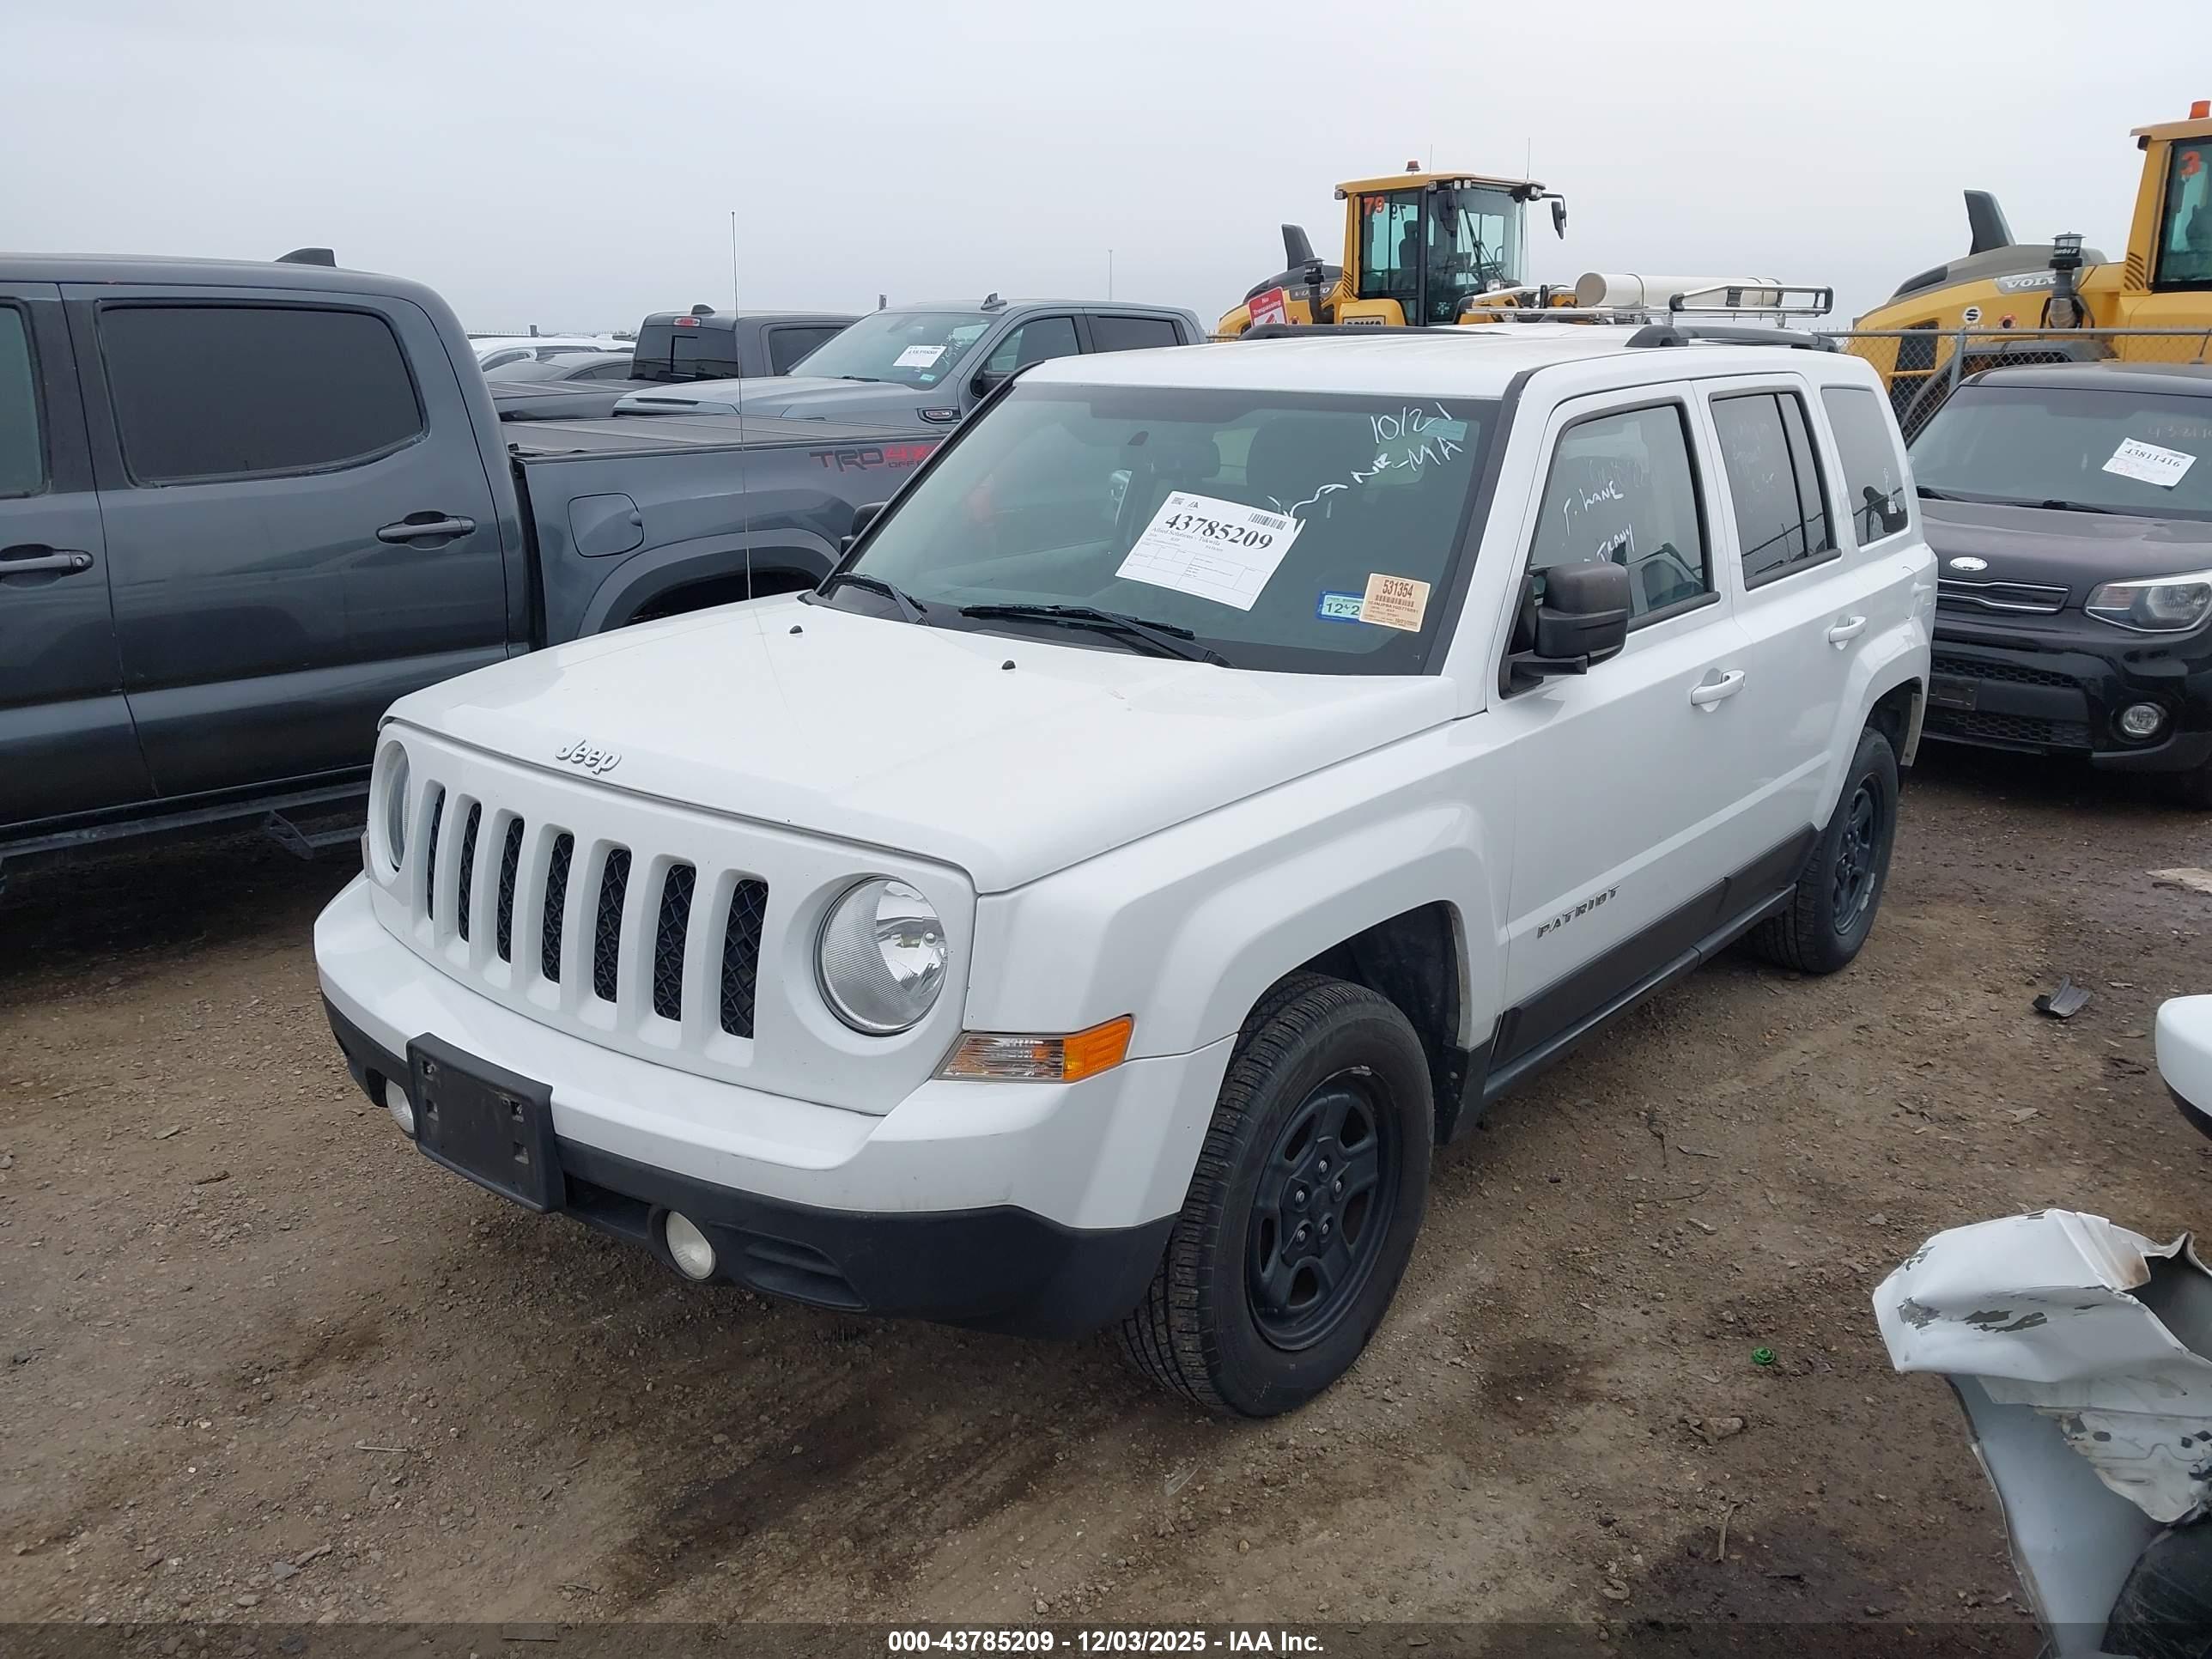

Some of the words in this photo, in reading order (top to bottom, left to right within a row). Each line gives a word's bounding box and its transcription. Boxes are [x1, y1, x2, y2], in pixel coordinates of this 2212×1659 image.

[2179, 150, 2201, 176] 3
[1364, 196, 1385, 216] 79
[2006, 275, 2075, 289] VOLV
[809, 447, 884, 472] TRD
[885, 444, 929, 459] 4X
[2124, 448, 2182, 468] 43811416
[1164, 514, 1273, 550] 43785209
[1382, 580, 1414, 598] 531354
[1326, 602, 1344, 614] 12
[1351, 605, 1360, 616] 2
[1537, 884, 1620, 939] PATRIOT
